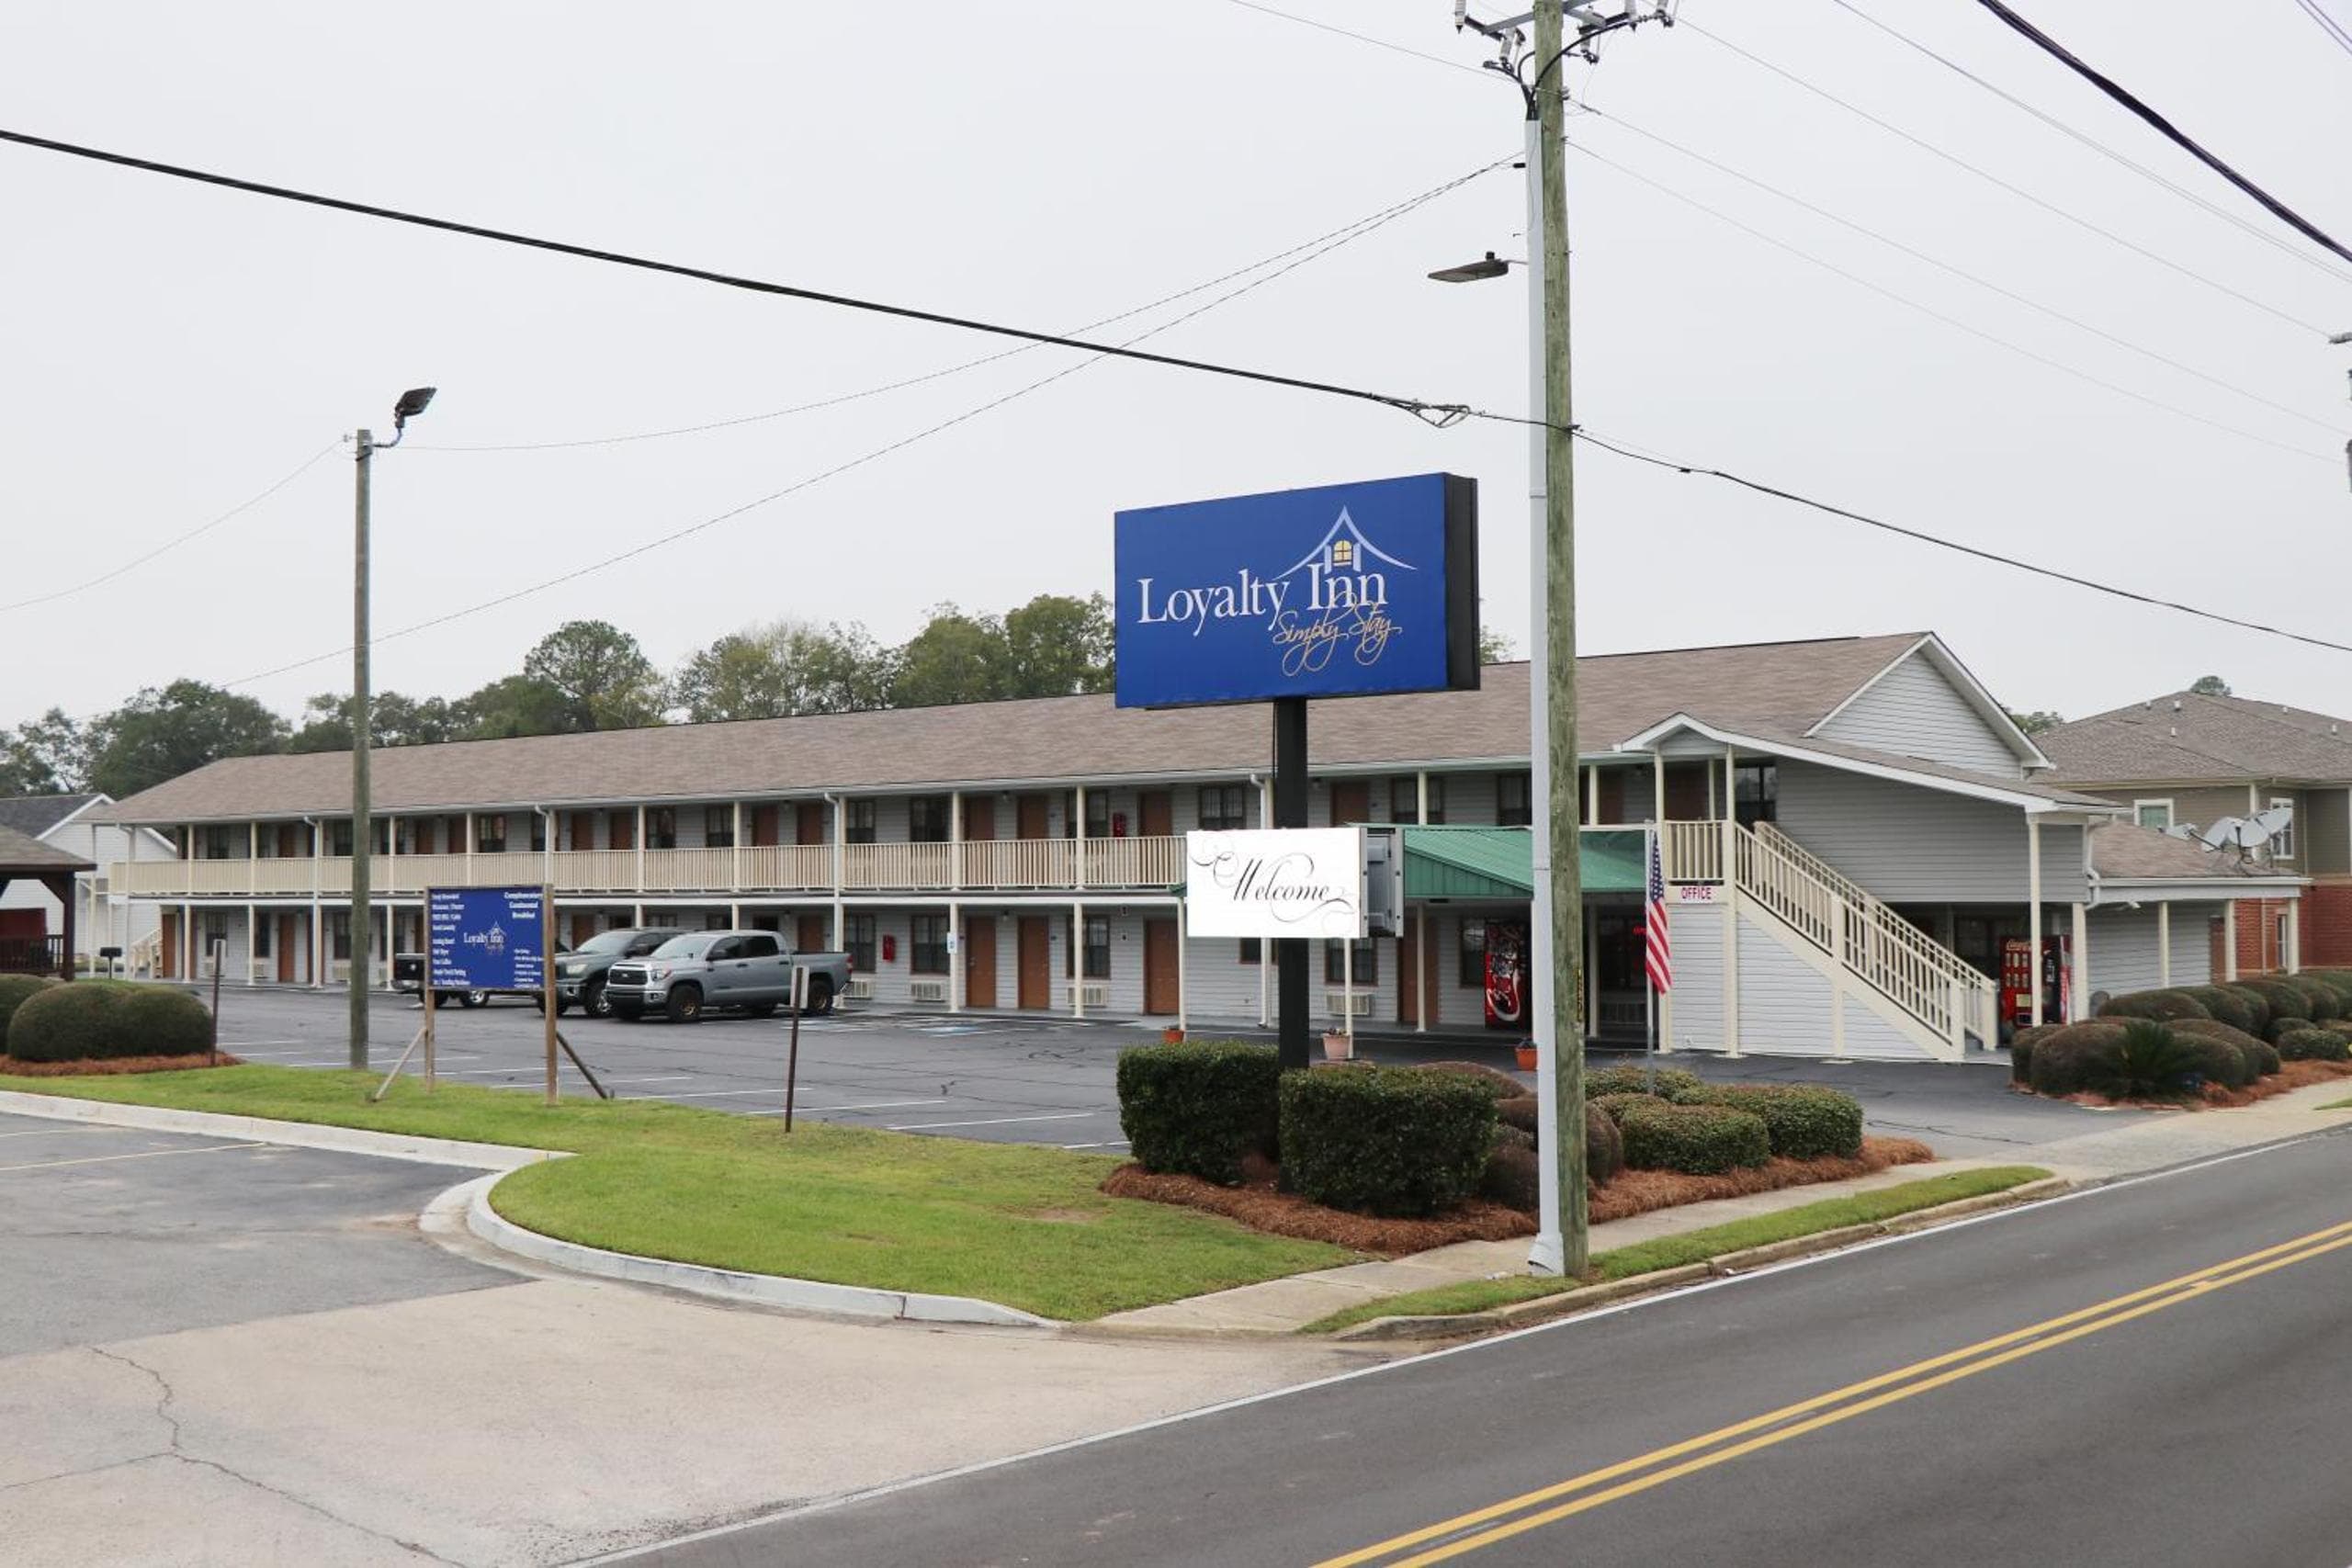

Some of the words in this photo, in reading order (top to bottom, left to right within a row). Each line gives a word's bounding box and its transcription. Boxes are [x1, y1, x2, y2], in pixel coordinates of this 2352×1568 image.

[1136, 569, 1290, 637] Loyalty
[1306, 562, 1388, 612] Inn
[1272, 591, 1357, 676] Simply
[1349, 603, 1402, 666] Stay
[1192, 851, 1353, 922] Welcome
[1680, 886, 1712, 899] OFFICE
[463, 931, 489, 947] Loyalty
